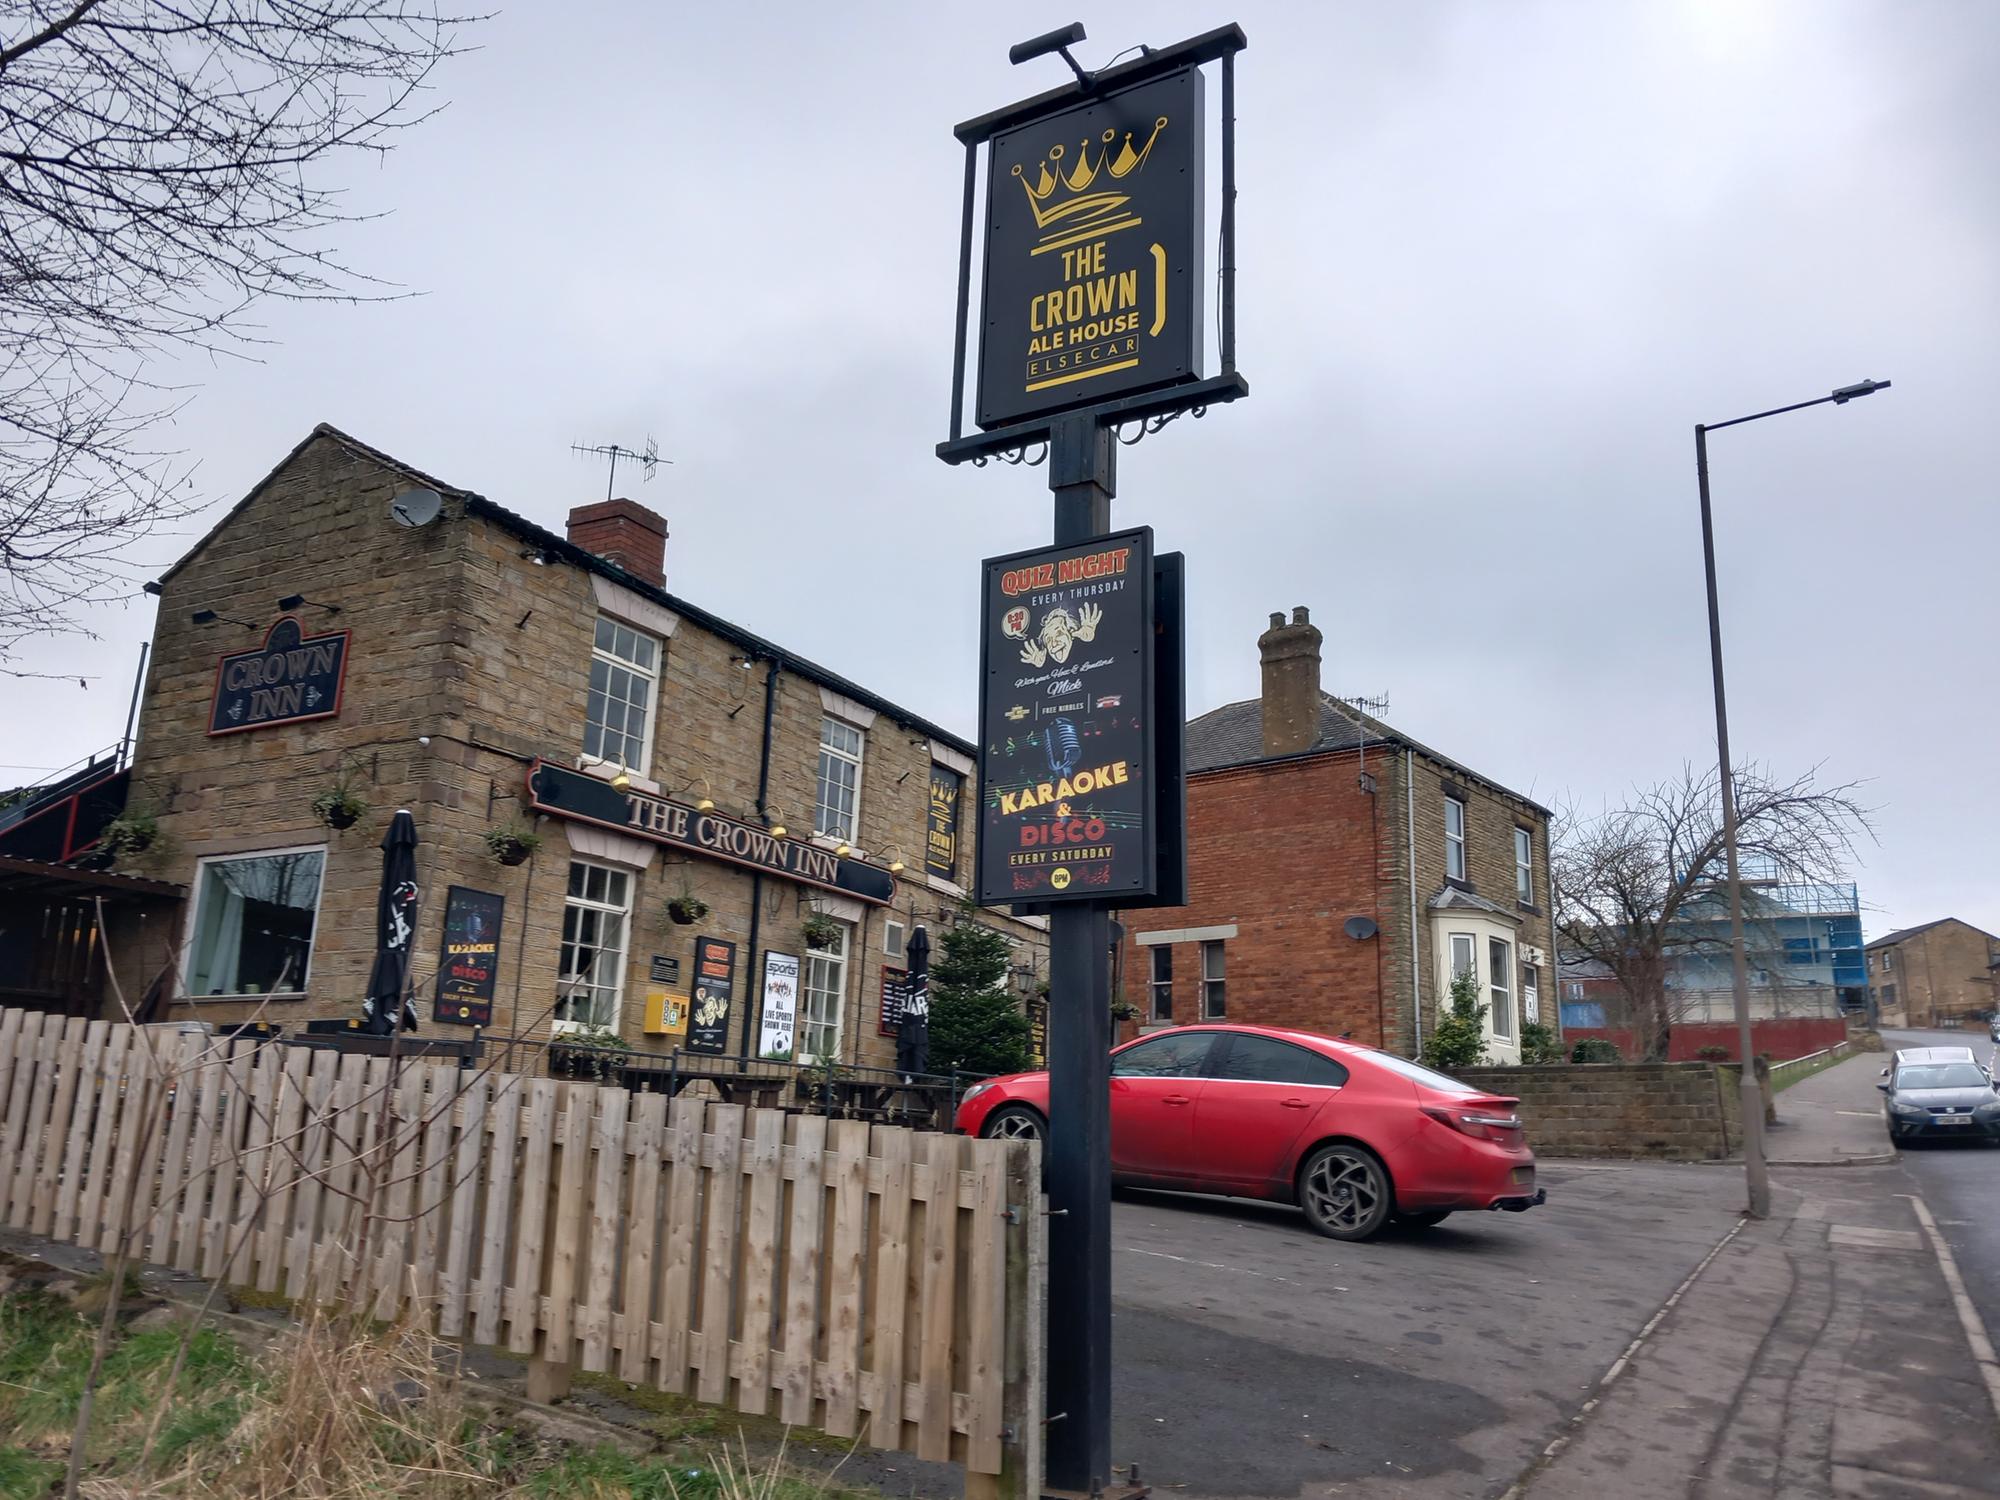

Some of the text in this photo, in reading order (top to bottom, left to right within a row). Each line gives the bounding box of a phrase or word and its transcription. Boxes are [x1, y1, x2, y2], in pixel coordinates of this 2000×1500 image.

[1061, 240, 1106, 281] THE
[1030, 269, 1137, 332] CROWN
[1028, 311, 1139, 355] ALE HOUSE
[1030, 338, 1135, 376] ELSECAR
[1002, 548, 1129, 596] QUIZ NIGHT
[1032, 580, 1125, 606] EVERY THURSDAY
[226, 643, 338, 692] CROWN
[247, 682, 306, 721] INN
[1047, 679, 1082, 695] Mick
[1042, 706, 1057, 715] FREE
[1058, 702, 1084, 712] NIBBLES
[1000, 761, 1129, 816] KARAOKE
[1056, 802, 1072, 817] &
[627, 793, 839, 884] THE CROWN INN
[1020, 817, 1105, 847] DISCO
[1010, 847, 1112, 865] EVERY SATURDAY
[448, 943, 496, 954] KARAOKE
[767, 962, 797, 976] sports
[765, 1009, 792, 1021] LIVE SPORTS
[775, 1000, 784, 1010] ALL
